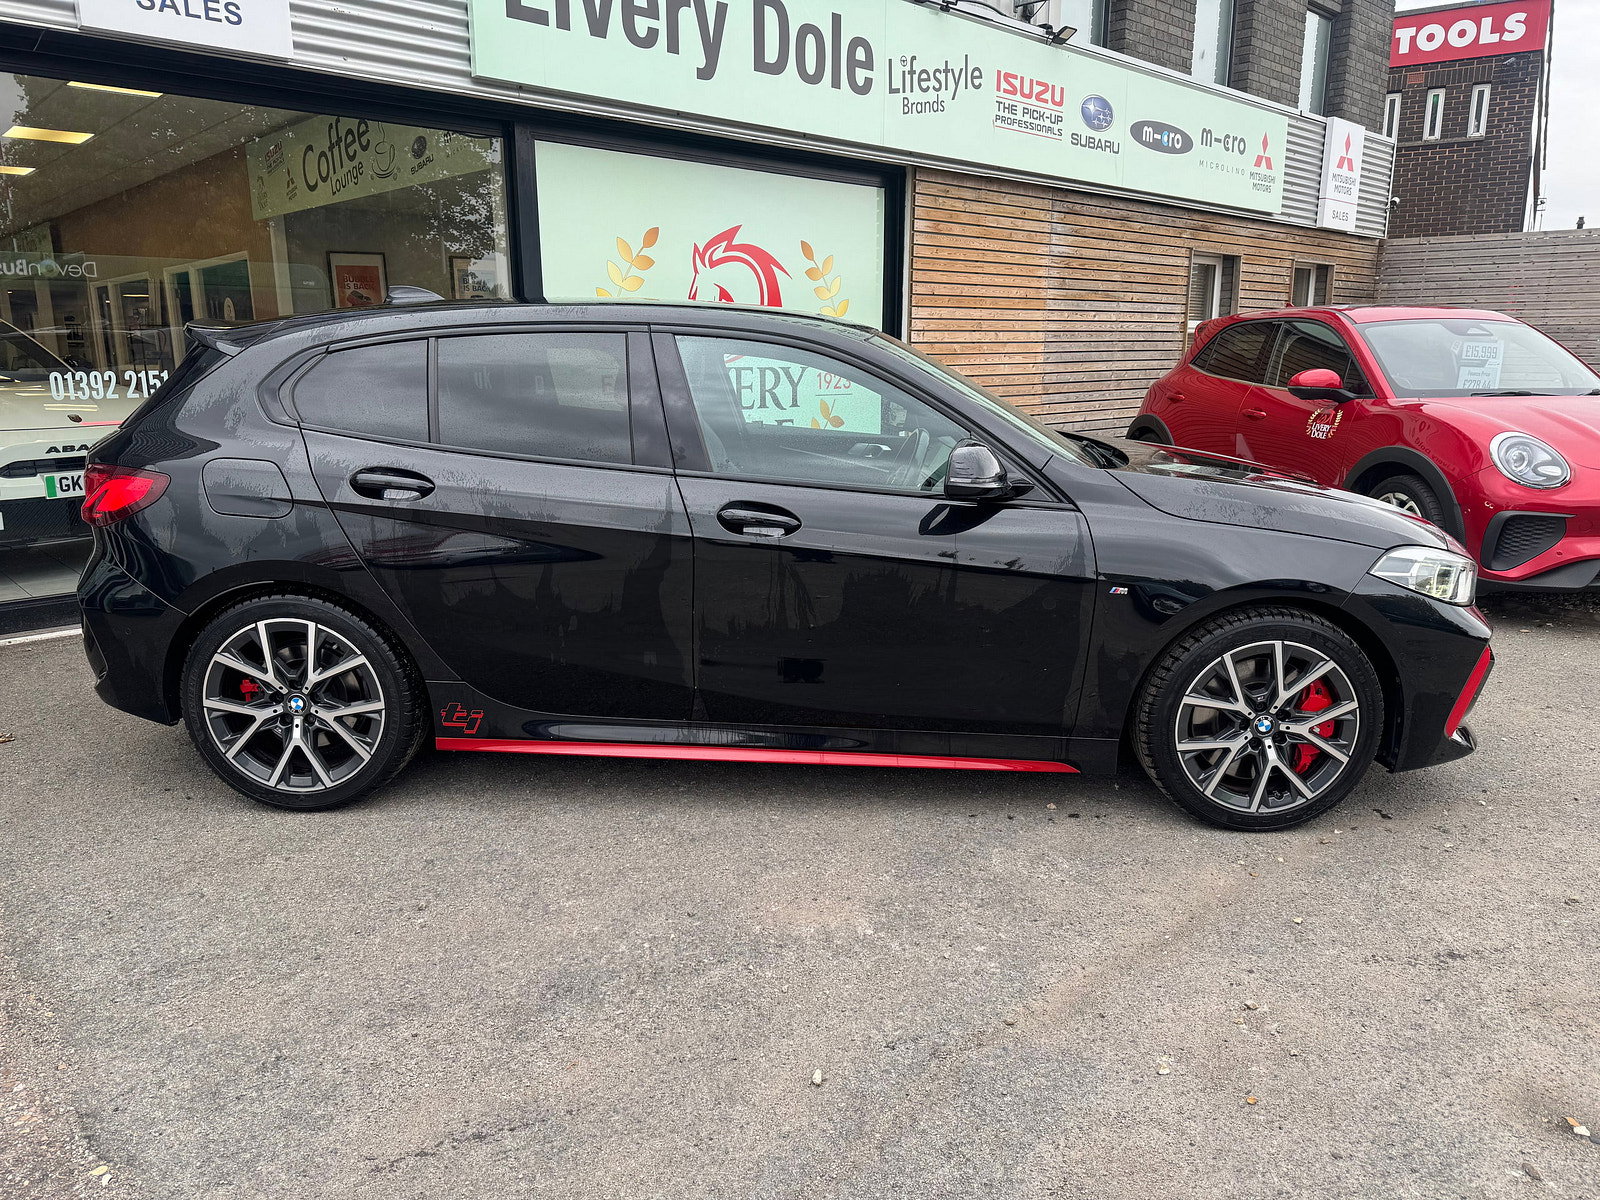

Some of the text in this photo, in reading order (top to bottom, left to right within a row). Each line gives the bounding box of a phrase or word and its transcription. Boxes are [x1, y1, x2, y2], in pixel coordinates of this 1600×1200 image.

[1395, 12, 1528, 55] TOOLS
[505, 0, 875, 96] very Dole
[888, 54, 983, 101] Lifestyle
[995, 69, 1065, 107] ISUZU
[902, 94, 946, 115] Brands
[995, 100, 1064, 126] THE PICK-UP
[994, 115, 1063, 137] PROFESSIONALS
[302, 115, 371, 192] Coffee
[1070, 133, 1120, 155] SUBARU
[410, 153, 434, 175] SUBARU
[1198, 159, 1246, 176] MICROLINO
[329, 160, 364, 196] Lounge
[1249, 171, 1276, 185] MITSUBISHI
[1252, 182, 1272, 194] MOTORS
[1331, 172, 1357, 187] MITSUBISHI
[1334, 183, 1352, 196] MOTORS
[1331, 209, 1349, 222] SALES
[50, 371, 120, 401] 01392
[1311, 430, 1327, 439] DOLE
[1312, 422, 1331, 432] LIVERY
[58, 475, 84, 493] GK
